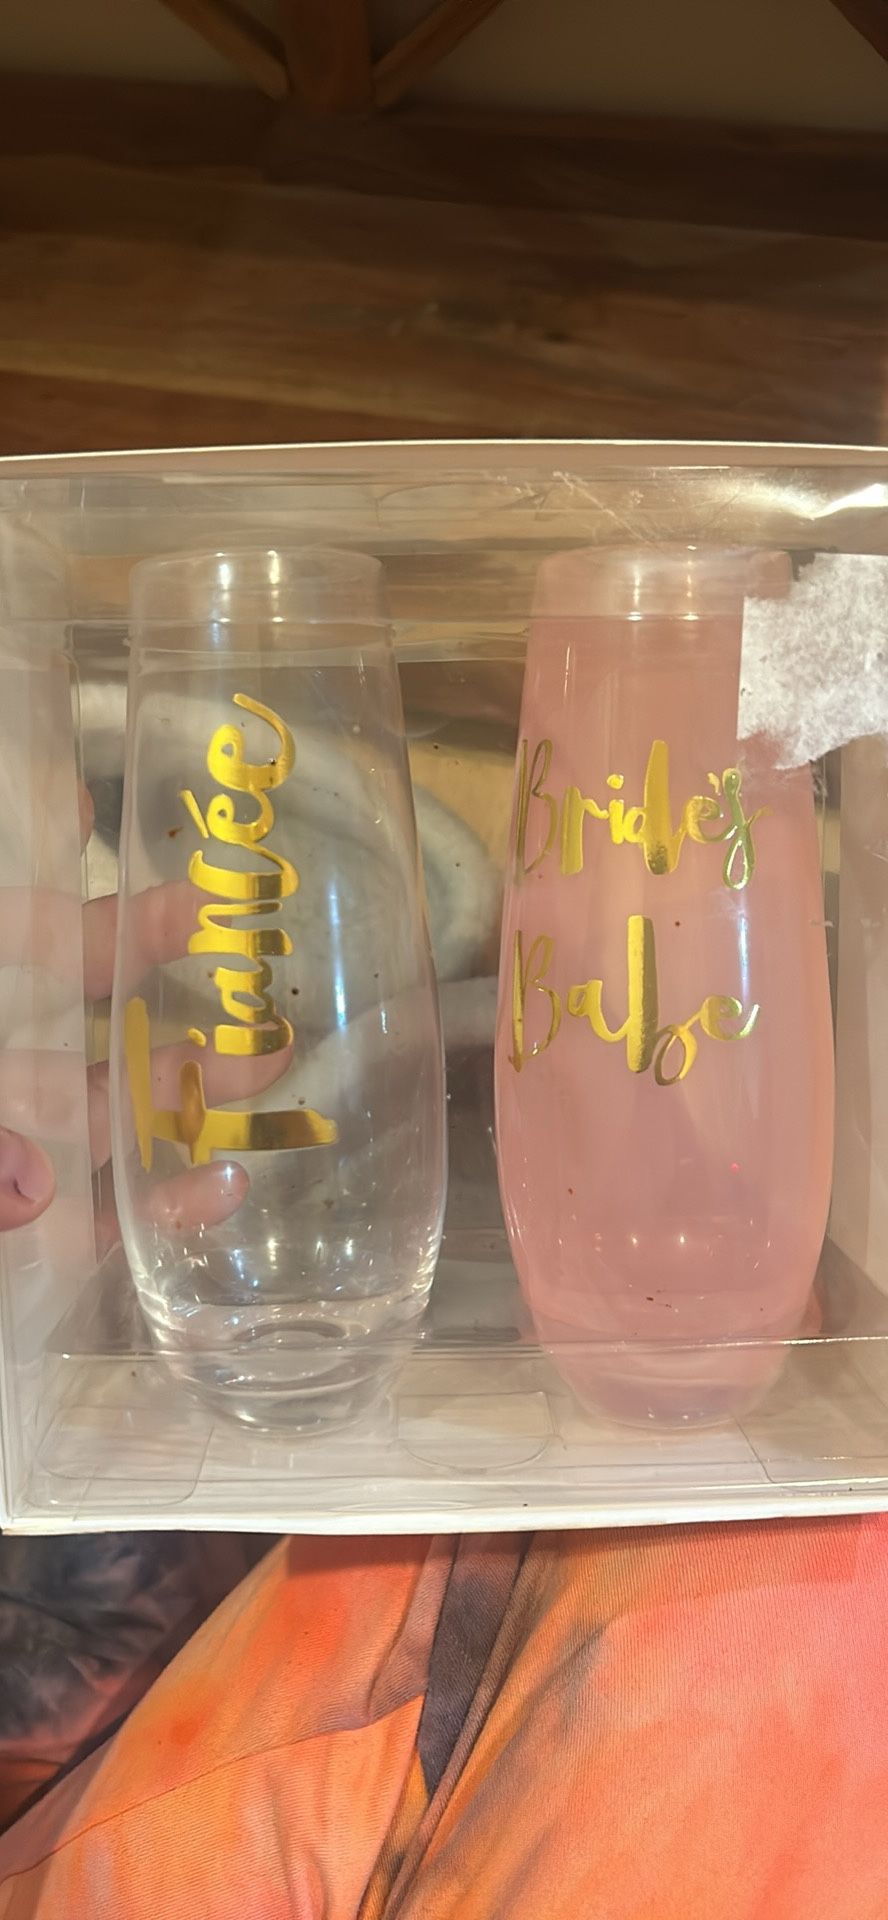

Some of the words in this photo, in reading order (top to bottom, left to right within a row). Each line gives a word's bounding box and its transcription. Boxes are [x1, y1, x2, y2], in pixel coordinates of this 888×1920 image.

[514, 739, 773, 890] Bride's
[125, 693, 338, 1171] Fiancée
[508, 915, 759, 1086] Babe
